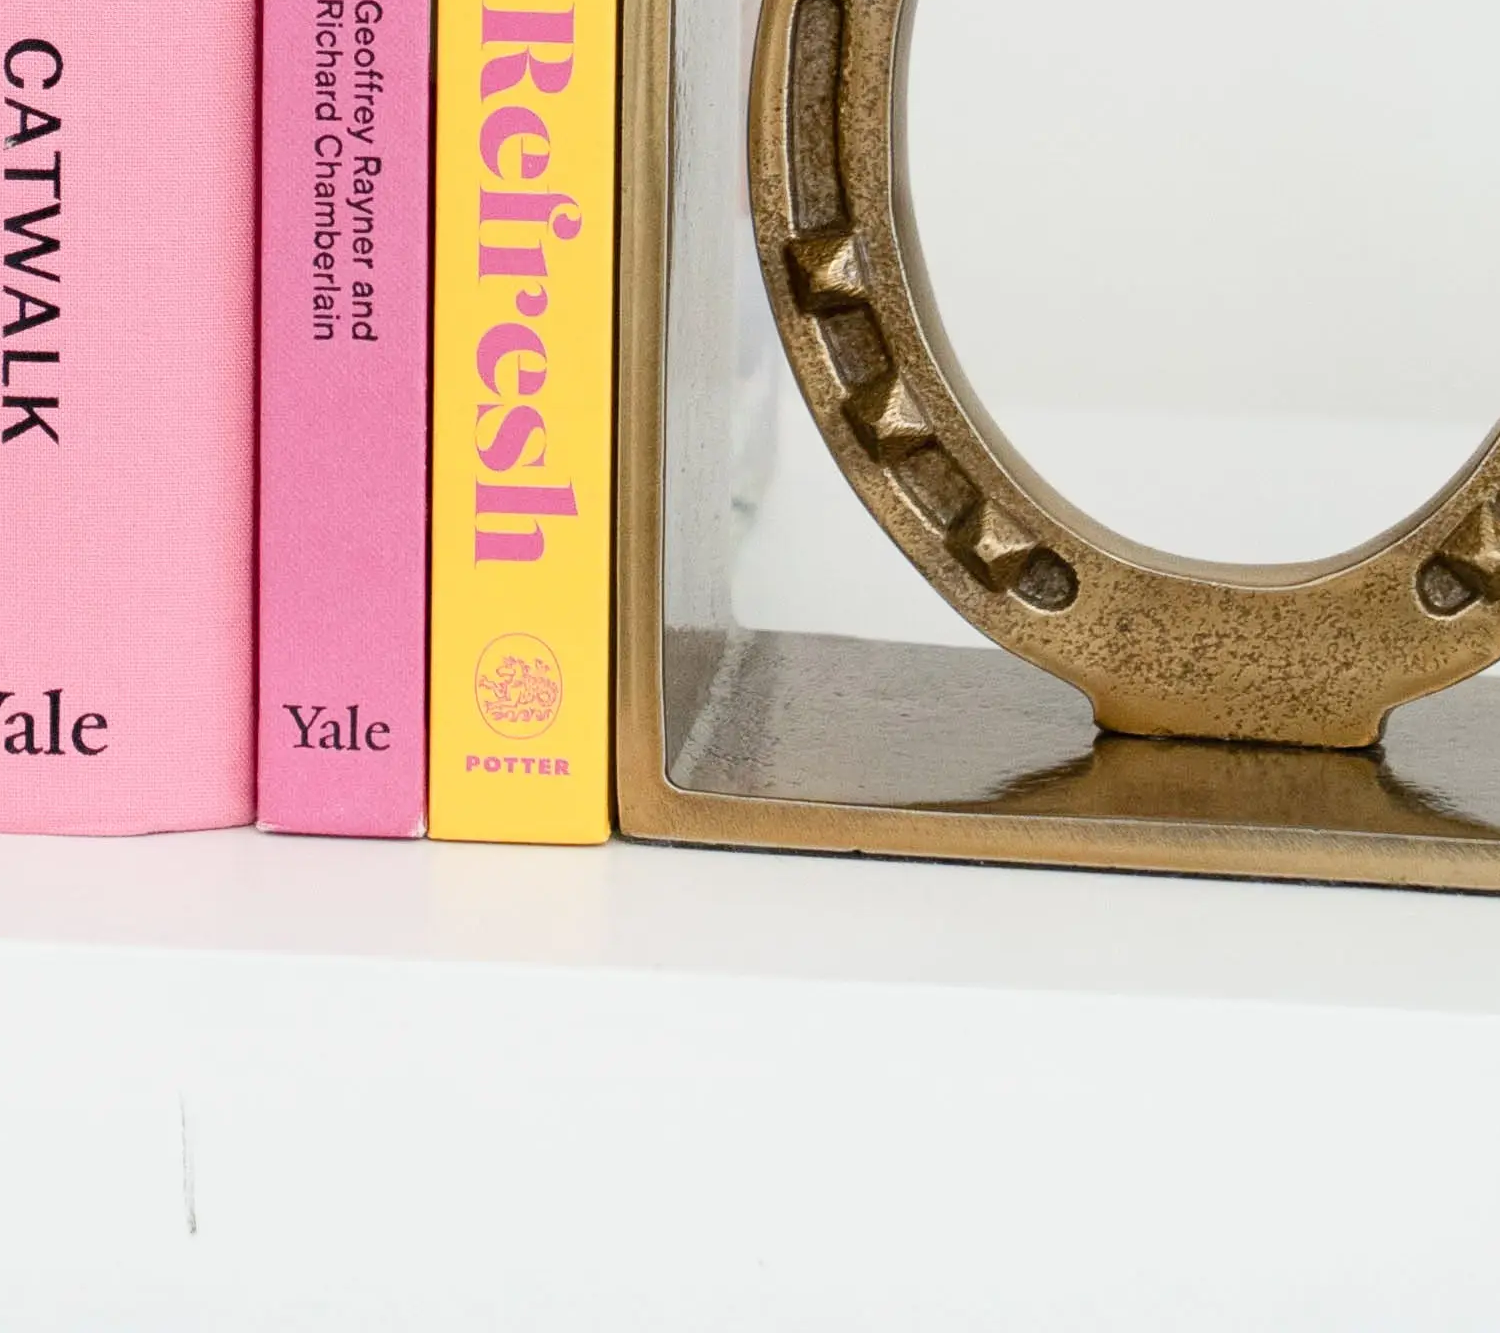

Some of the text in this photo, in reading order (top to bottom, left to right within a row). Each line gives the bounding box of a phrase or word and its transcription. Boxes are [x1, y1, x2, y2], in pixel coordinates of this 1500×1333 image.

[0, 37, 65, 445] CATWALK
[311, 133, 344, 342] Chamberlain
[348, 155, 383, 271] Rayner
[350, 280, 379, 343] and
[474, 1, 582, 569] Refresh
[282, 703, 391, 752] Yale
[464, 754, 571, 777] POTTER
